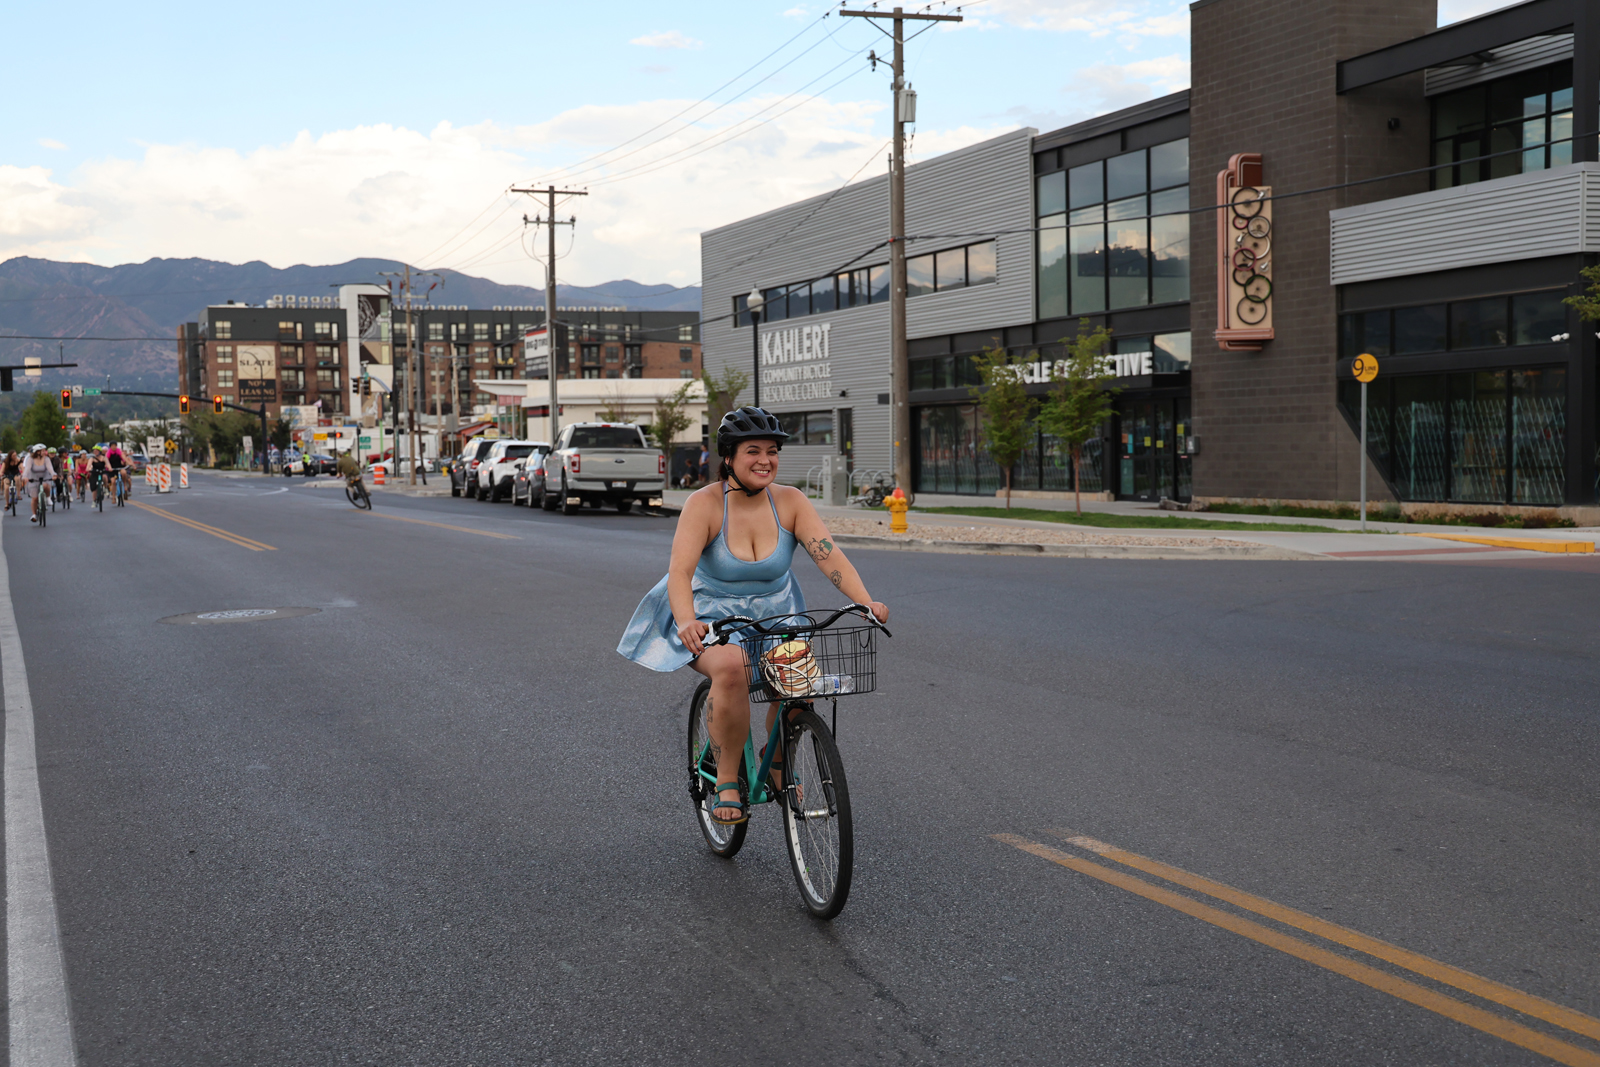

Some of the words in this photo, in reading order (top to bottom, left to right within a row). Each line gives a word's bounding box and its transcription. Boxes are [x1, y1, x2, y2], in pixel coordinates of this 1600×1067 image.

[762, 323, 831, 365] KAHLERT
[763, 366, 802, 384] COMMUNITY
[803, 363, 831, 379] BICYCLE
[992, 361, 1052, 386] BYCLE
[1053, 351, 1153, 379] COECTIVE
[1353, 358, 1364, 376] 9
[763, 383, 801, 402] RESOURCE
[802, 380, 832, 400] CENTER
